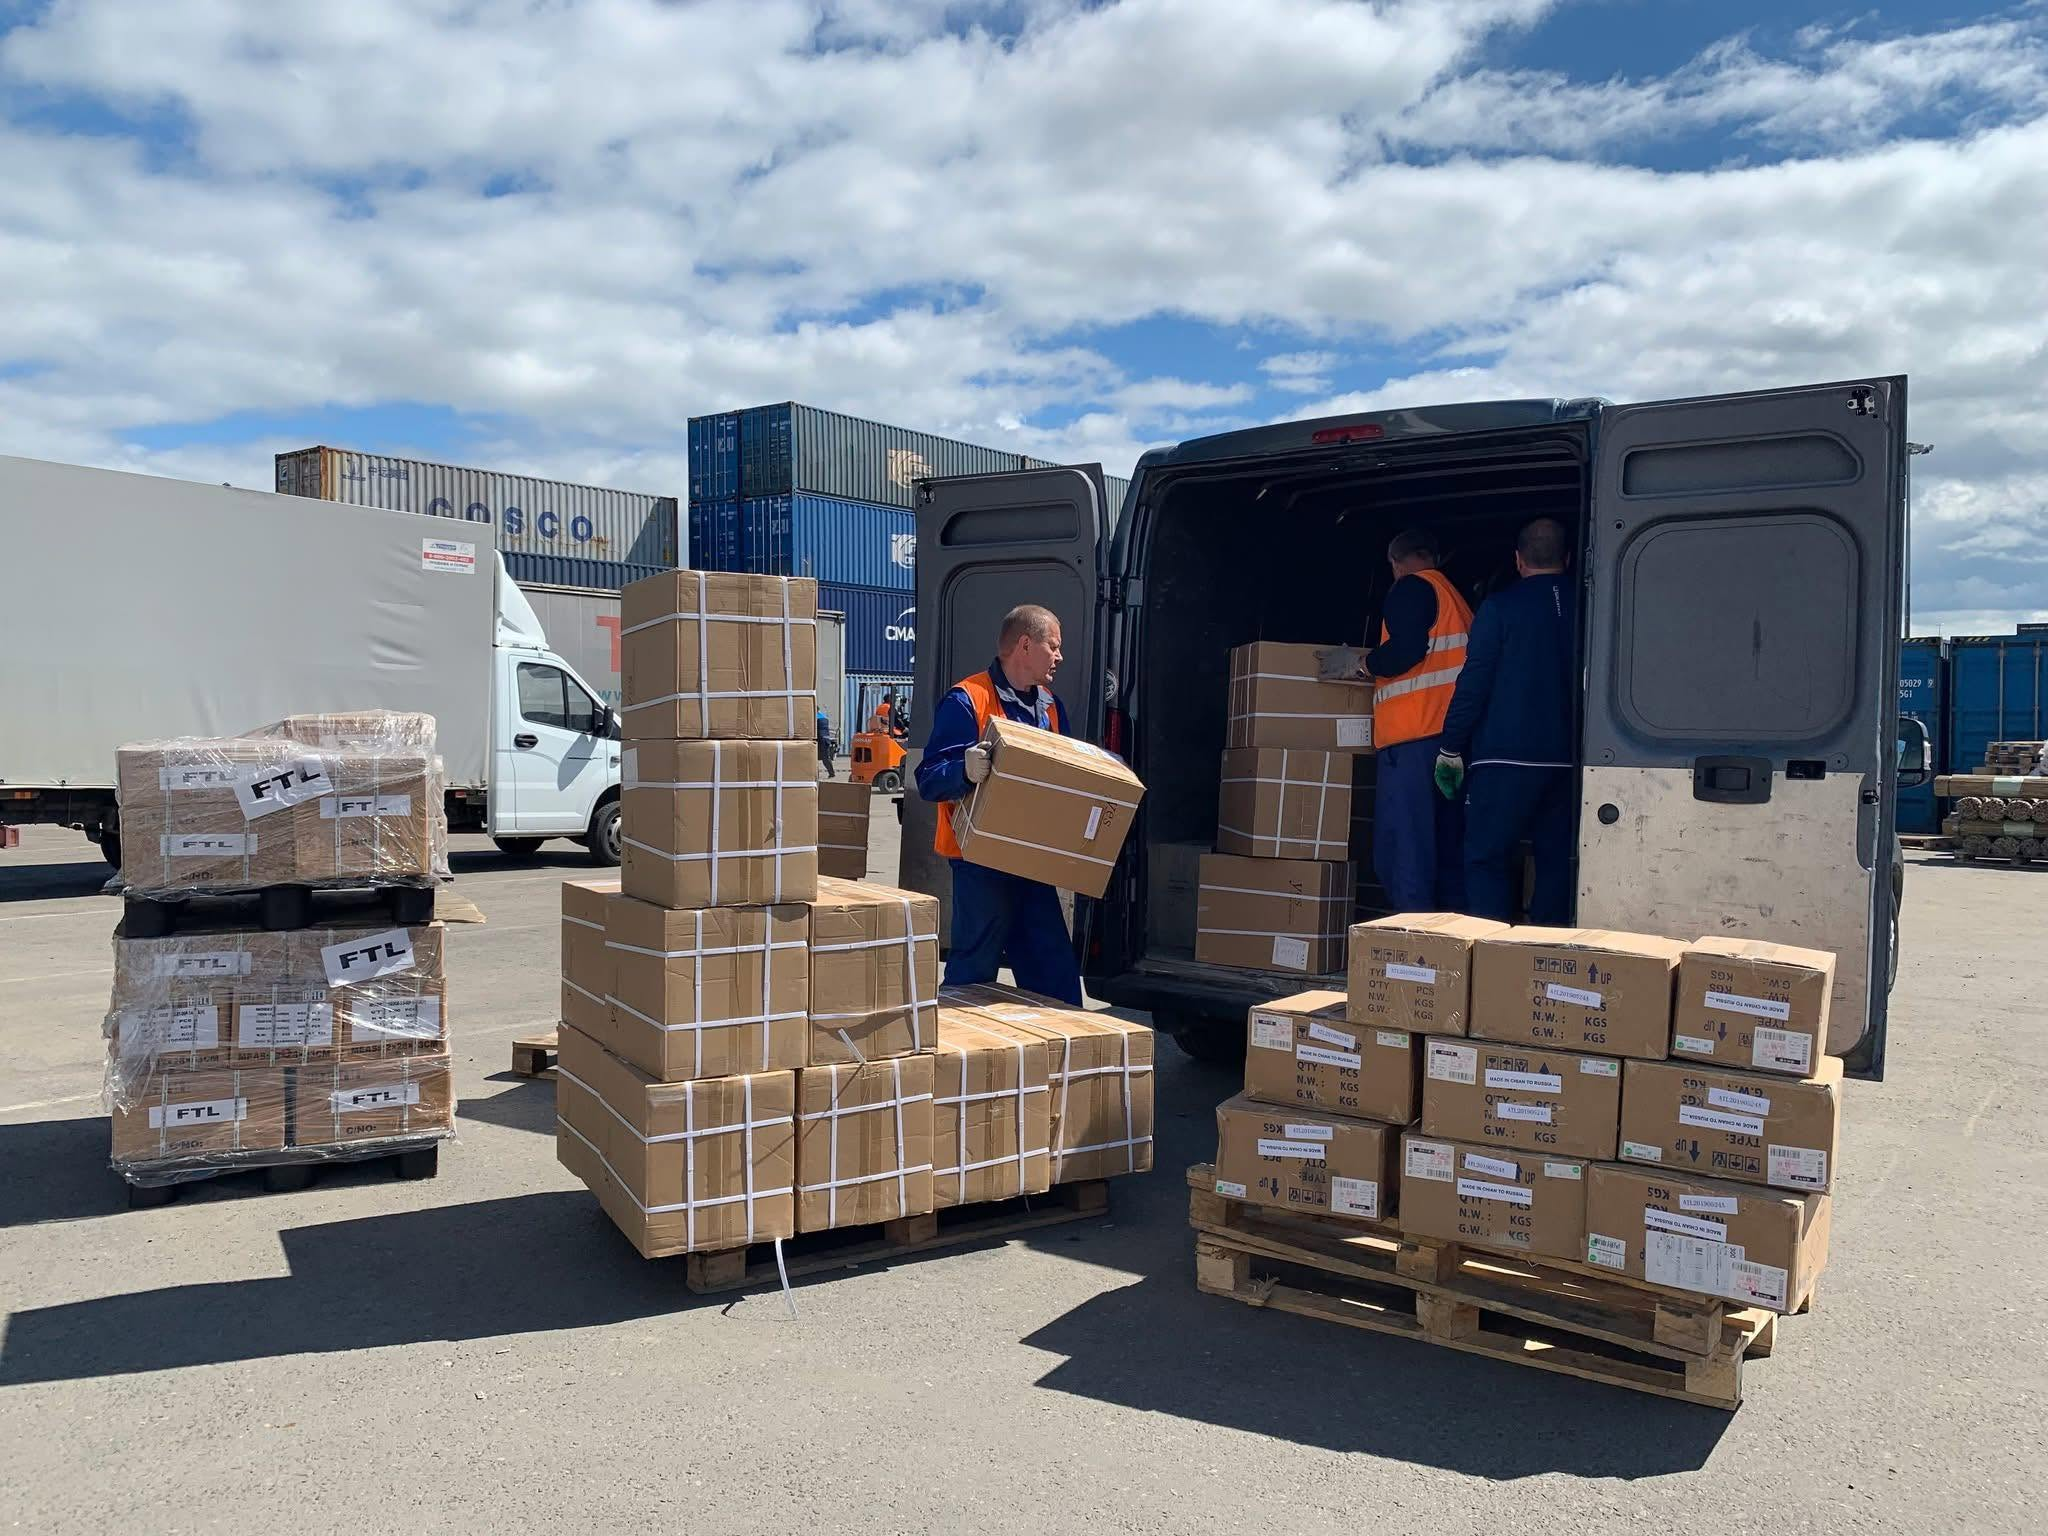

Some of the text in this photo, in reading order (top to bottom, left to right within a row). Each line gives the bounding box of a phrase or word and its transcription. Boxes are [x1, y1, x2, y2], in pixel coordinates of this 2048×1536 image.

[428, 497, 593, 542] COSCO
[885, 625, 915, 641] CMA
[183, 771, 238, 782] FTL
[251, 763, 320, 799] FTL
[338, 942, 406, 970] FTL
[178, 958, 226, 969] FTL
[1600, 972, 1612, 984] UP
[1711, 970, 1734, 982] KGS
[1416, 986, 1434, 996] PCS
[1415, 998, 1434, 1008] KGS
[1414, 1010, 1433, 1020] KGS
[1585, 1017, 1607, 1028] KGS
[1703, 1020, 1715, 1032] UP
[1584, 1032, 1606, 1043] KGS
[1340, 1068, 1358, 1078] PCS
[1340, 1082, 1358, 1092] KGS
[1683, 1078, 1706, 1089] KGS
[353, 1092, 397, 1104] FTL
[1340, 1096, 1358, 1106] KGS
[1681, 1094, 1704, 1107] KGS
[178, 1106, 220, 1119] FTL
[1264, 1123, 1282, 1134] KGS
[1534, 1132, 1556, 1143] KGS
[1726, 1133, 1760, 1148] TYPE:
[1676, 1138, 1687, 1152] UP
[1259, 1178, 1268, 1188] UP
[1525, 1172, 1536, 1184] UP
[1648, 1187, 1670, 1200] KGS
[1510, 1216, 1532, 1227] KGS
[1509, 1230, 1530, 1242] KGS
